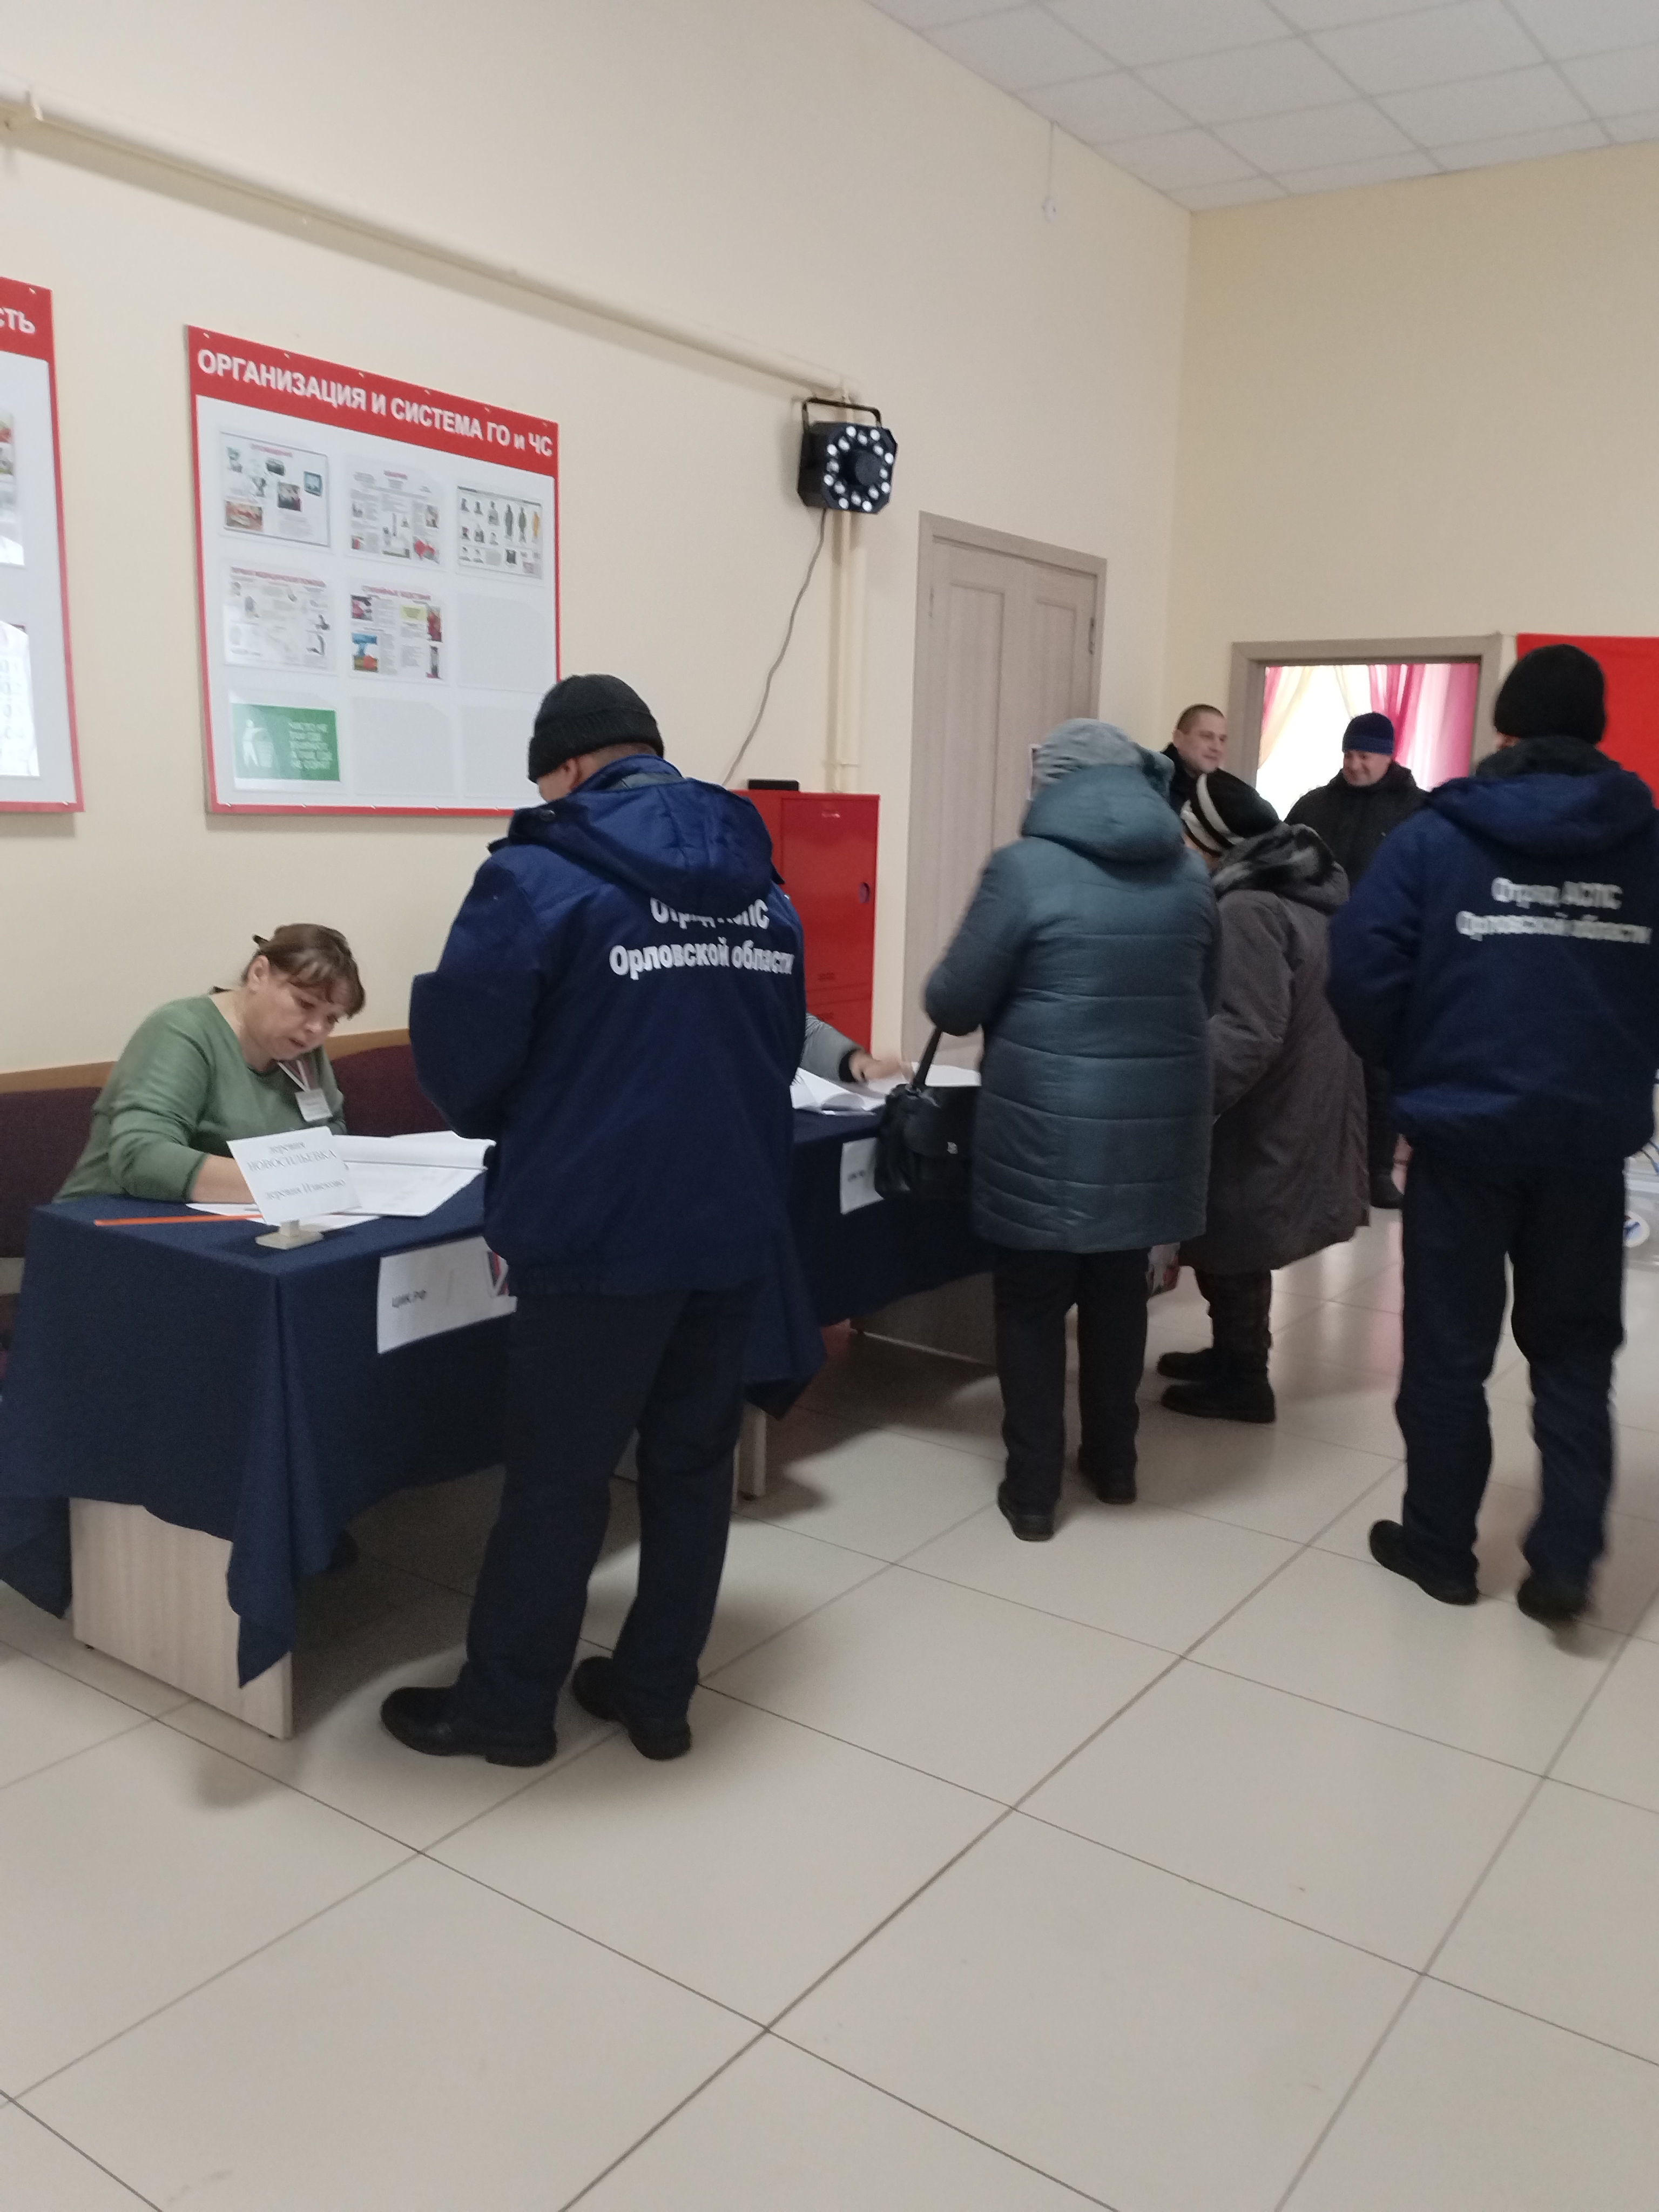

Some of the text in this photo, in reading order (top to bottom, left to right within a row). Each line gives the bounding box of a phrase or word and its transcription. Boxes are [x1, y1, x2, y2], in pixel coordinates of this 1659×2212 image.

[0, 307, 36, 334] ТЬ
[197, 349, 553, 457] ОРГАНИЗАЦИЯ И СИСТЕМА ГО и ЧС
[609, 936, 730, 980] Орловской
